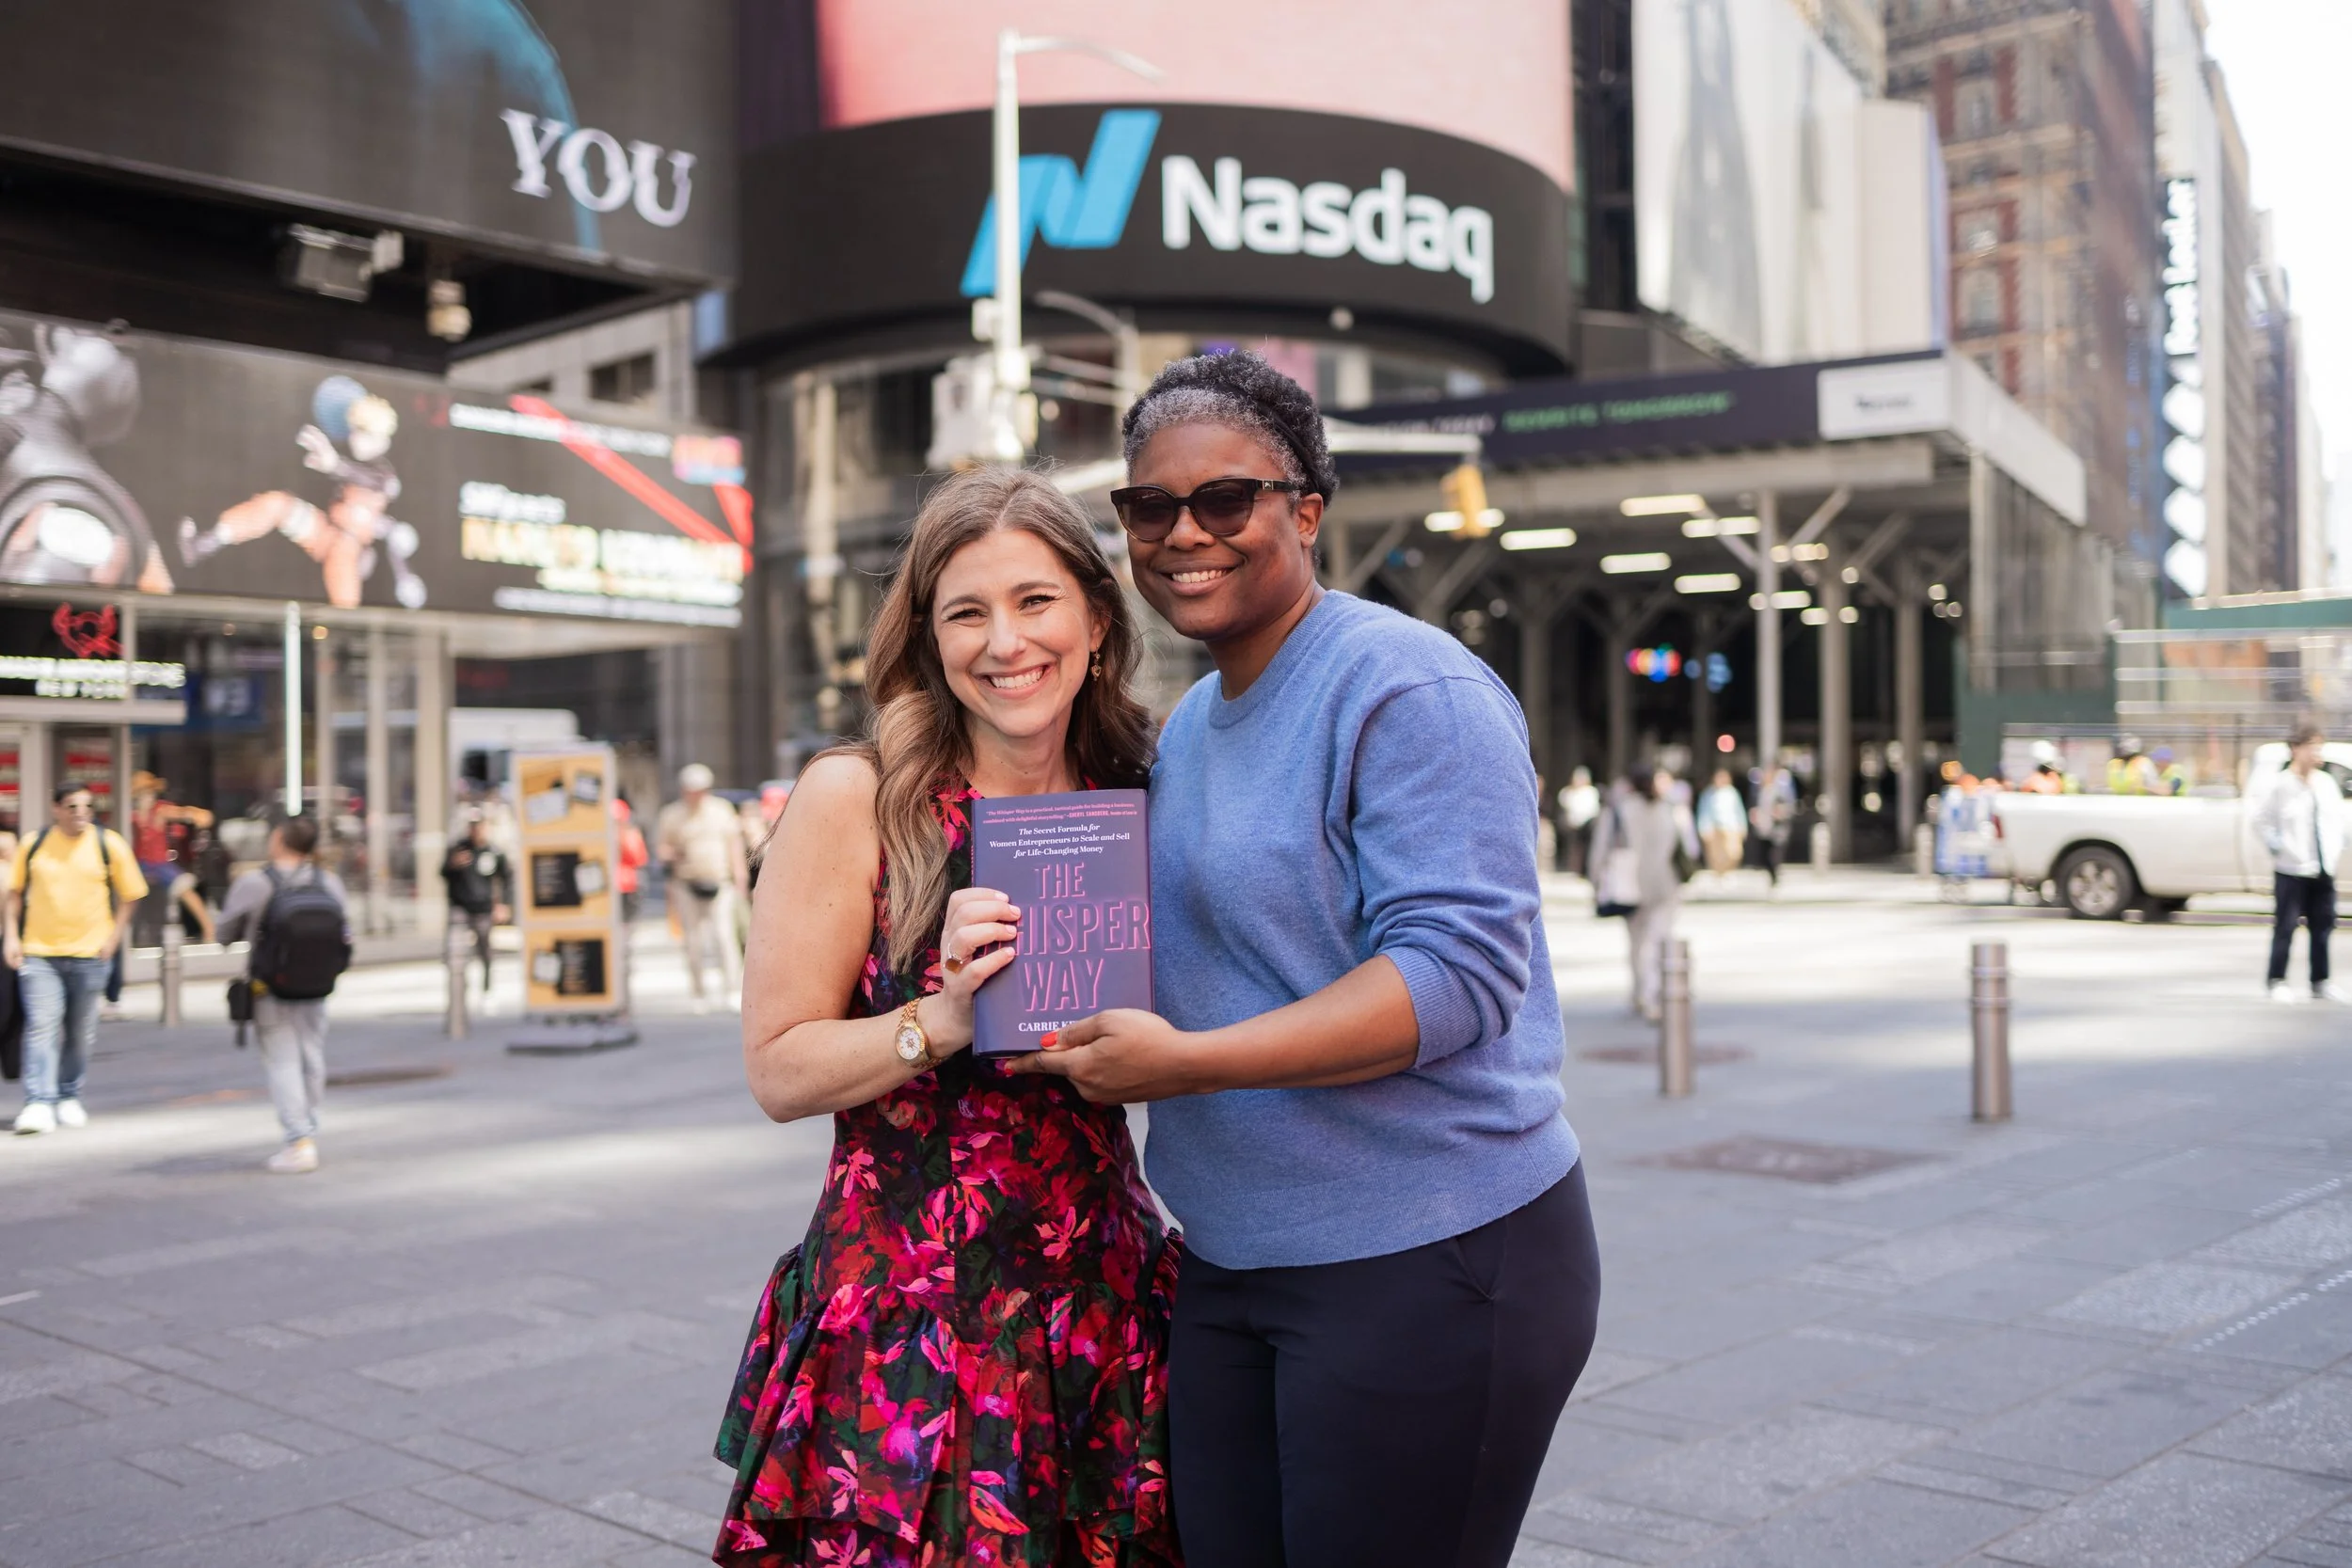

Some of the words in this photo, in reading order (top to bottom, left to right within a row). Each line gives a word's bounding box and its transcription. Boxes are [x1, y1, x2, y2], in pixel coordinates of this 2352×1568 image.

[500, 108, 697, 228] YOU
[1161, 155, 1494, 304] Nasdaq
[990, 839, 1017, 847] Women
[1018, 836, 1071, 847] Entrepreneurs
[1080, 834, 1100, 843] Scale
[1116, 832, 1130, 841] Sell
[1033, 826, 1056, 834] Secret
[1057, 824, 1088, 833] Formula
[1089, 823, 1101, 832] for
[1013, 849, 1026, 859] for
[1027, 847, 1078, 857] Life-Changing
[1079, 846, 1104, 854] Money
[1034, 862, 1085, 899] THE
[978, 901, 1151, 957] HISPER
[1019, 958, 1104, 1012] WAY
[1018, 1021, 1058, 1032] CARRIE
